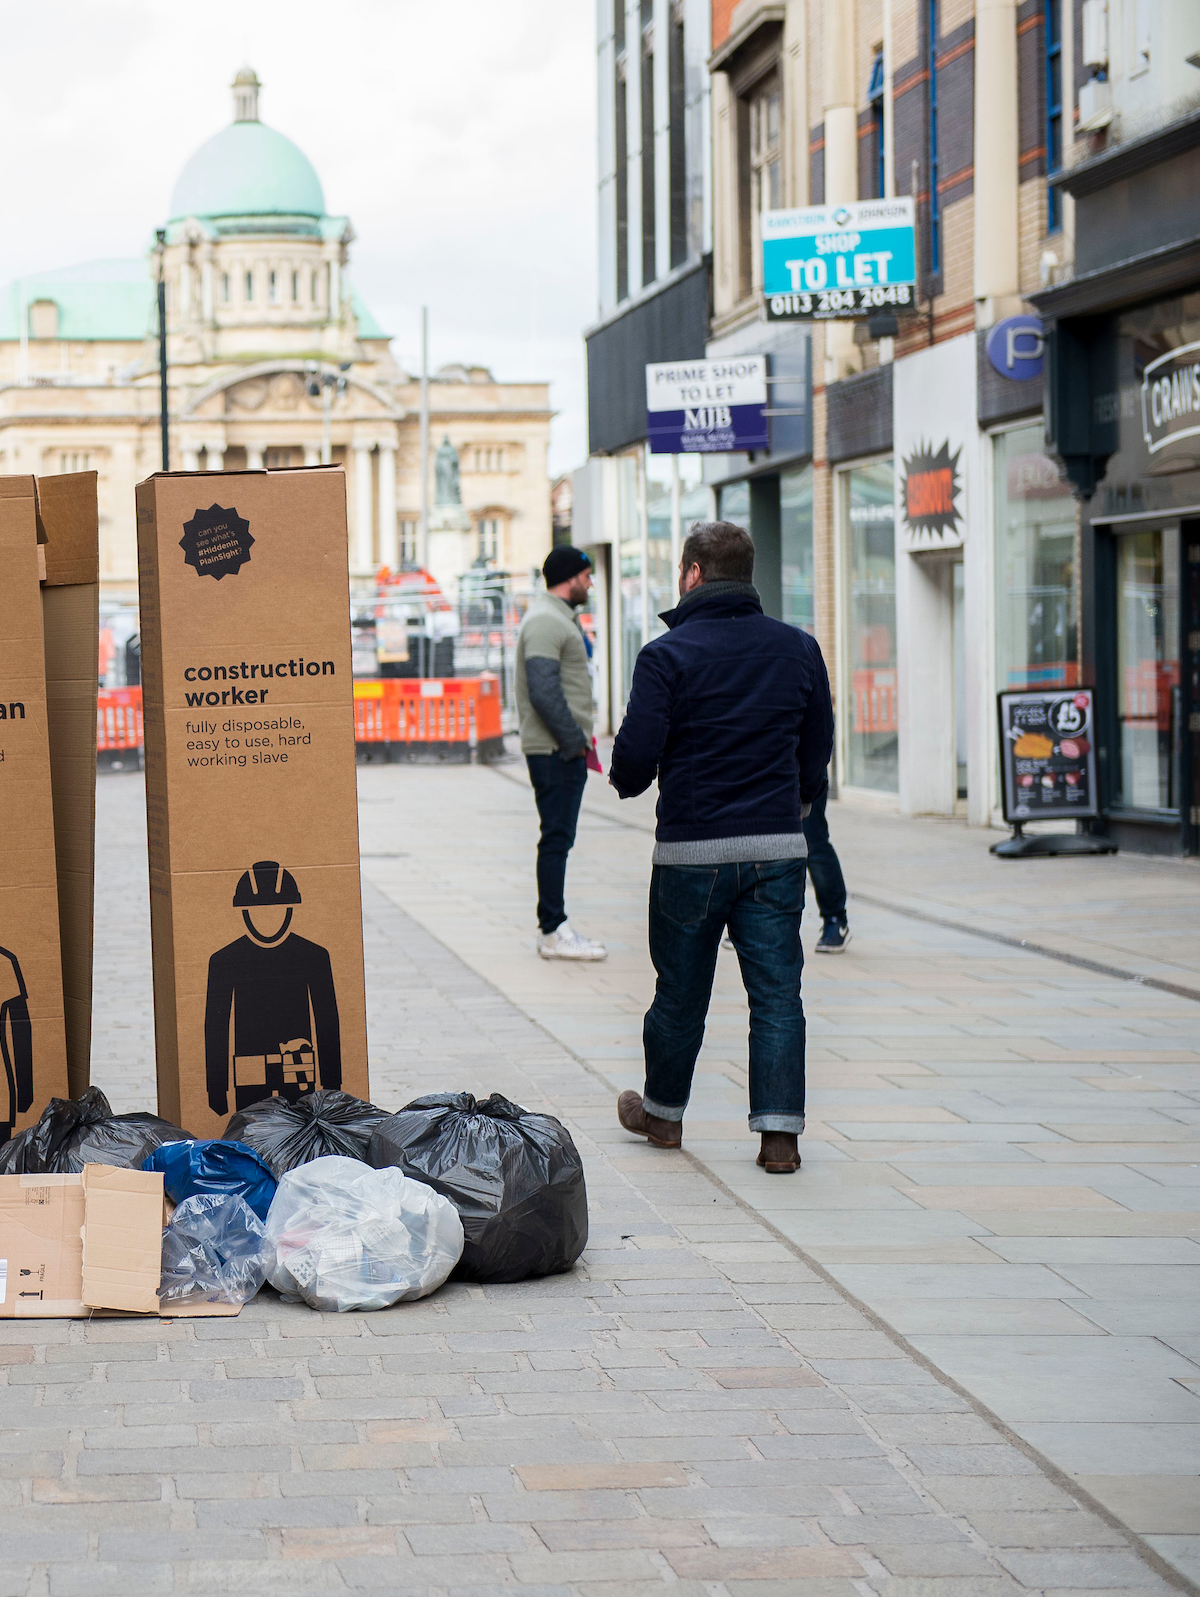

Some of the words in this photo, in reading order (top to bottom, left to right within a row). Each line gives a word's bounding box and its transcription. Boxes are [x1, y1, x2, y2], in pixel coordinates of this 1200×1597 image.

[815, 232, 861, 255] SHOP
[785, 257, 828, 291] TO
[836, 251, 893, 287] LET
[770, 293, 813, 315] 0113
[817, 290, 855, 311] 204
[860, 284, 911, 308] 2048
[655, 369, 707, 385] PRIME
[712, 362, 758, 380] SHOP
[681, 387, 701, 402] TO
[706, 384, 734, 399] LET
[684, 406, 732, 434] MJB
[196, 538, 209, 548] see
[210, 530, 235, 543] what's
[197, 528, 212, 537] can
[213, 523, 228, 533] you
[198, 539, 239, 557] #HiddenIn
[199, 547, 242, 566] PlainSight?
[184, 658, 335, 682] construction
[184, 686, 269, 706] worker
[185, 720, 217, 735] fully
[222, 717, 305, 733] disposable,
[186, 739, 220, 751] easy
[225, 737, 240, 749] to
[245, 736, 274, 748] use,
[278, 732, 311, 746] hard
[187, 754, 247, 767] working
[252, 751, 289, 765] slave
